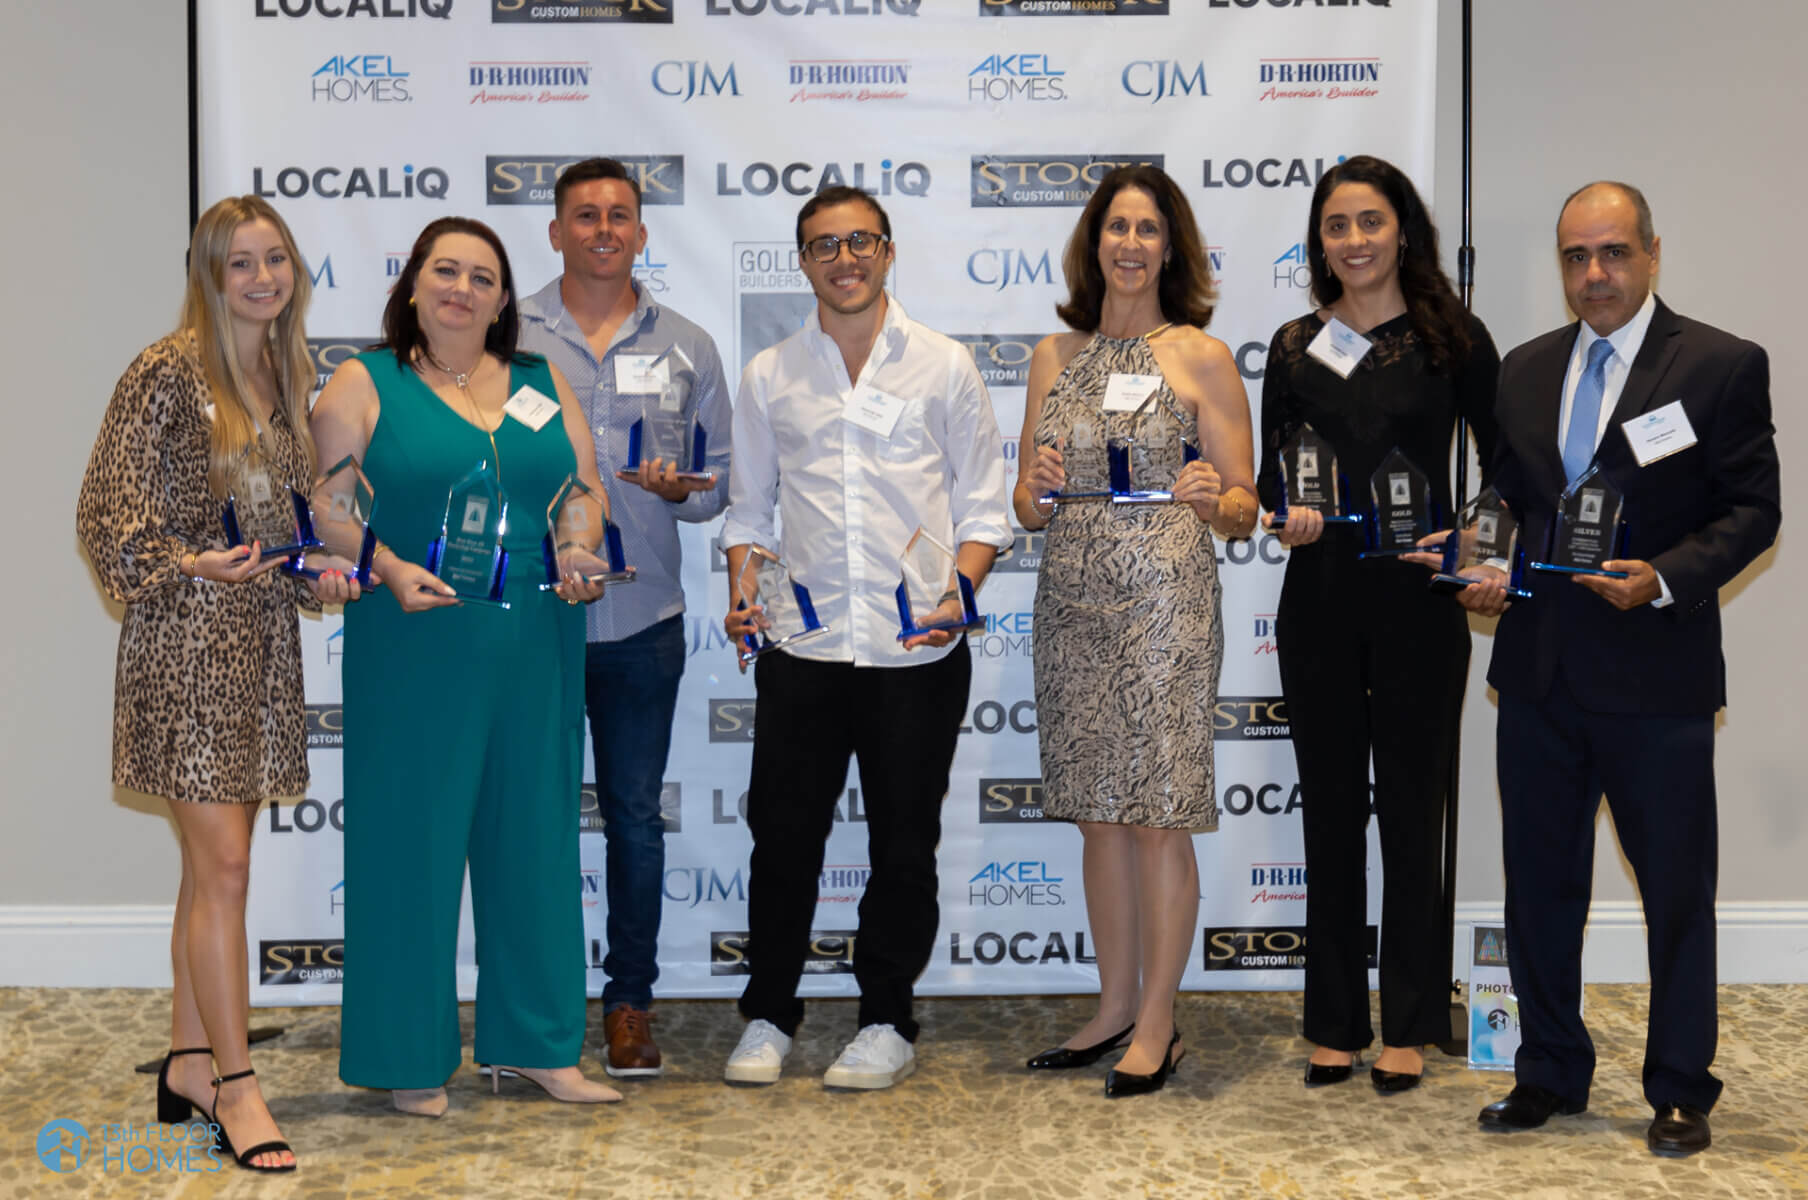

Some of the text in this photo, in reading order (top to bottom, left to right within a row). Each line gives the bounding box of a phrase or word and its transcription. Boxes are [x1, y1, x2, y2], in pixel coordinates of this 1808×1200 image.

[312, 55, 410, 77] AKEL
[968, 54, 1066, 76] AKEL
[651, 60, 744, 103] CJM
[1121, 60, 1213, 104] CJM
[470, 89, 590, 104] America's Builder
[857, 89, 908, 102] Builder
[1259, 86, 1379, 101] America's Builder
[967, 248, 1055, 291] CJM
[740, 275, 802, 288] BUILDERS
[968, 862, 1064, 883] AKEL
[662, 866, 746, 908] CJM
[951, 932, 1097, 966] LOCAL
[1209, 932, 1306, 960] STO
